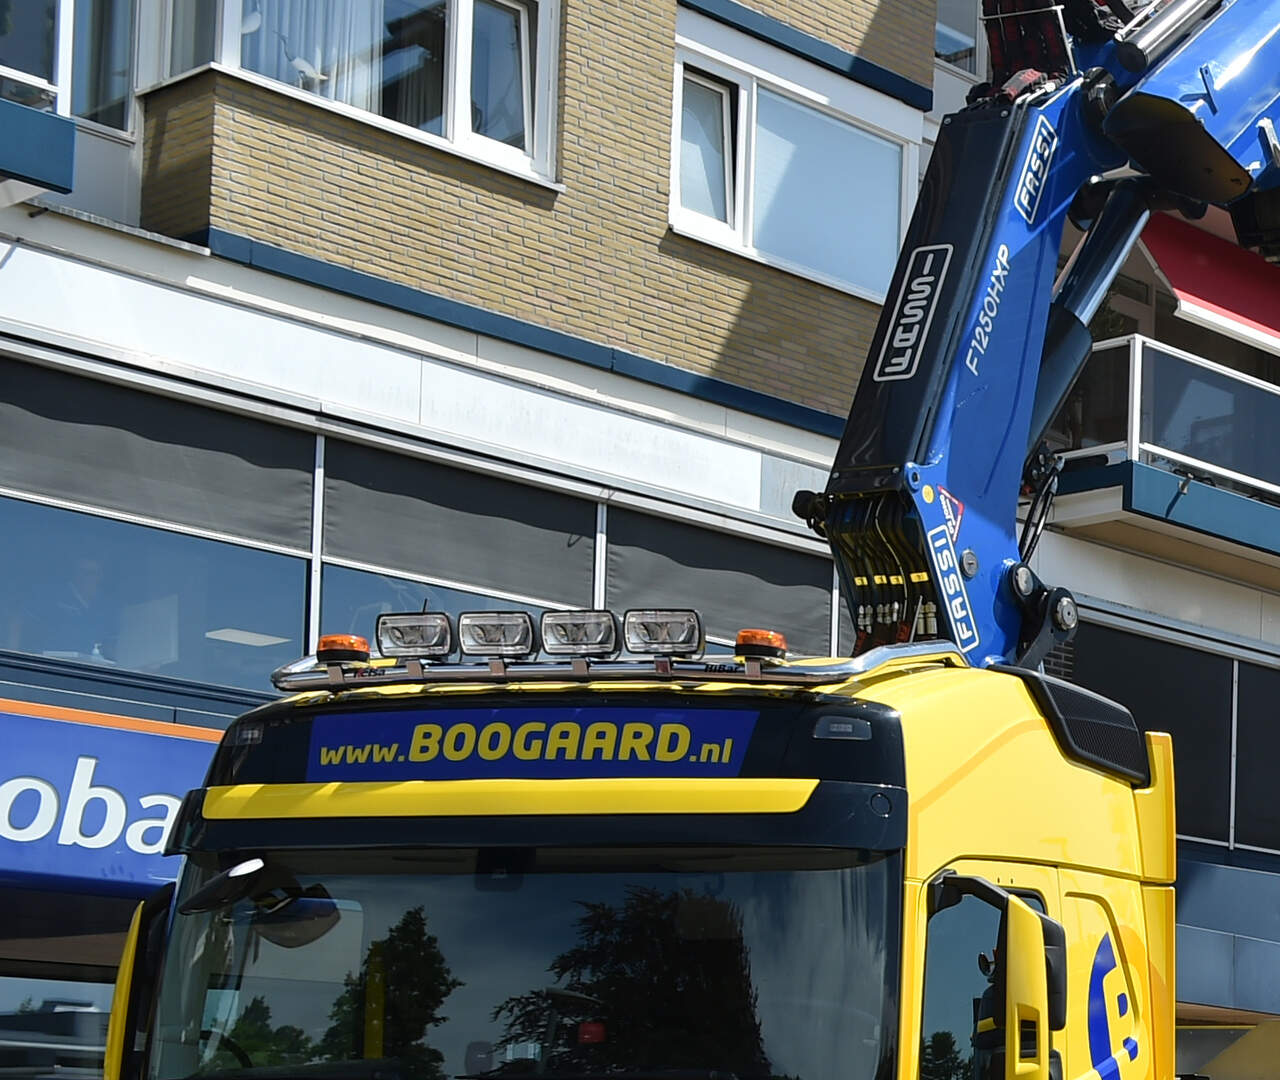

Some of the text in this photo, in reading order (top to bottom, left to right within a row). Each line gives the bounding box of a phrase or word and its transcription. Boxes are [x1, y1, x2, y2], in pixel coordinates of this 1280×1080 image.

[1020, 127, 1052, 213] FASSI
[884, 253, 935, 373] FASSI
[965, 243, 1010, 376] F1250HXP
[934, 537, 973, 640] FASSI
[320, 721, 734, 766] www.BOOGAARD.nl
